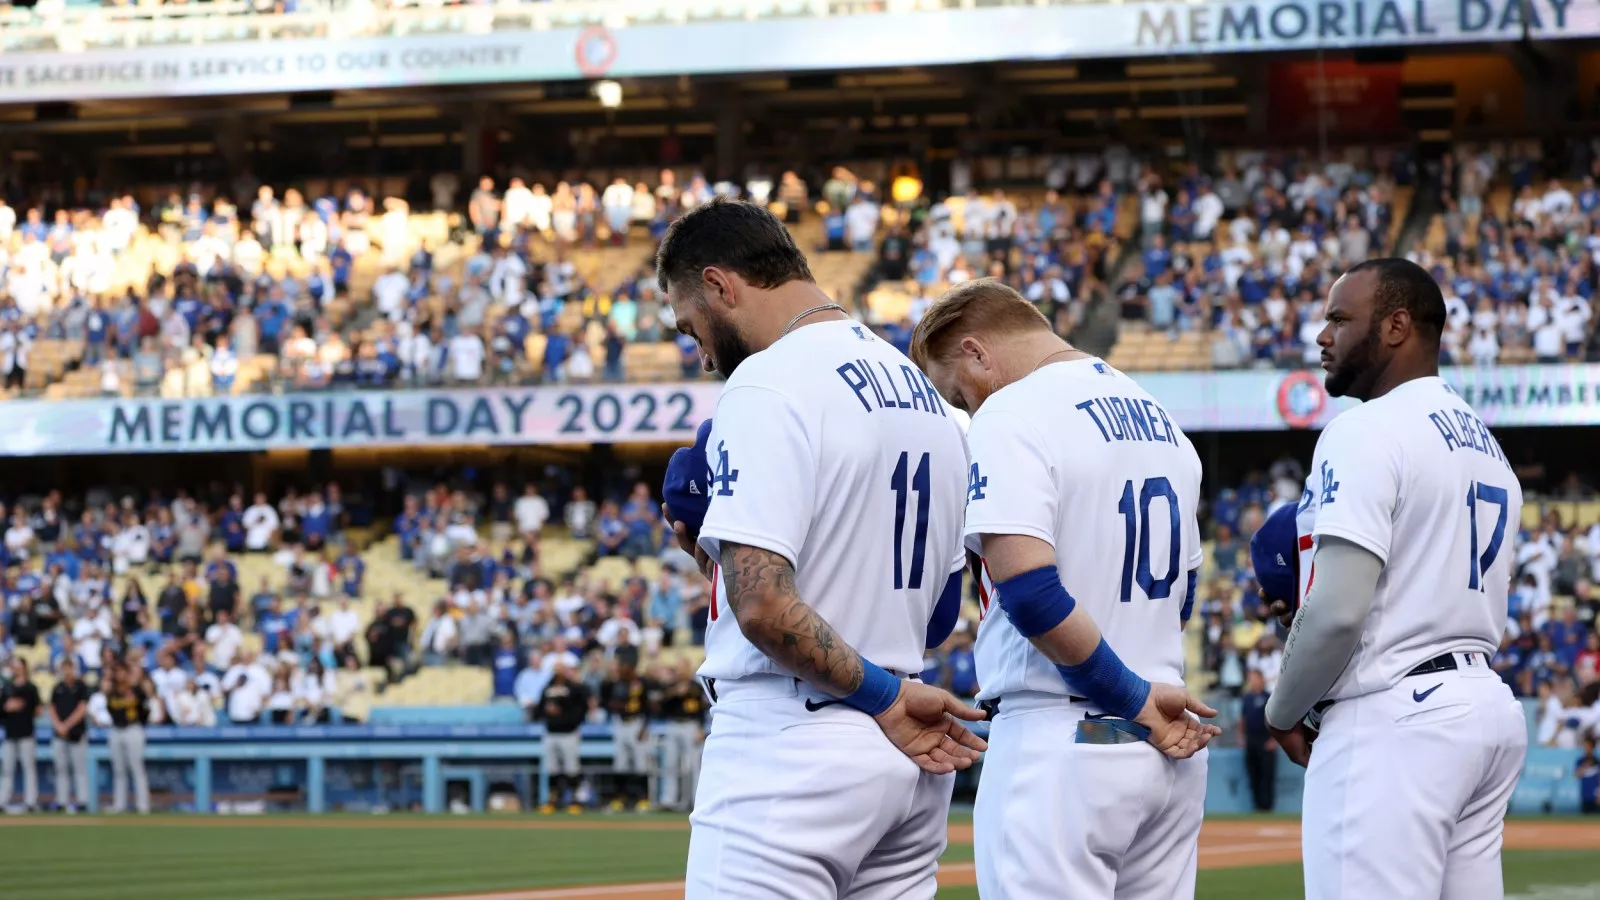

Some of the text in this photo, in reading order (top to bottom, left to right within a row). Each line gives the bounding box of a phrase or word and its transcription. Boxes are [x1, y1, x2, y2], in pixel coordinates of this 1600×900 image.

[1137, 0, 1573, 47] MEMORIAL DAY
[26, 62, 144, 85] SACRIFICE
[151, 61, 180, 81] IN
[190, 54, 284, 78] SERVICE
[297, 51, 326, 74] TO
[337, 48, 391, 71] OUR
[399, 44, 523, 69] COUNTRY
[109, 391, 695, 442] MEMORIAL DAY 2022
[1454, 383, 1600, 406] EMEMBE
[1075, 396, 1179, 447] TURNER
[967, 462, 988, 505] A
[891, 451, 931, 589] 11
[1118, 476, 1181, 603] 10
[1467, 479, 1508, 593] 17
[1294, 604, 1309, 633] HOME
